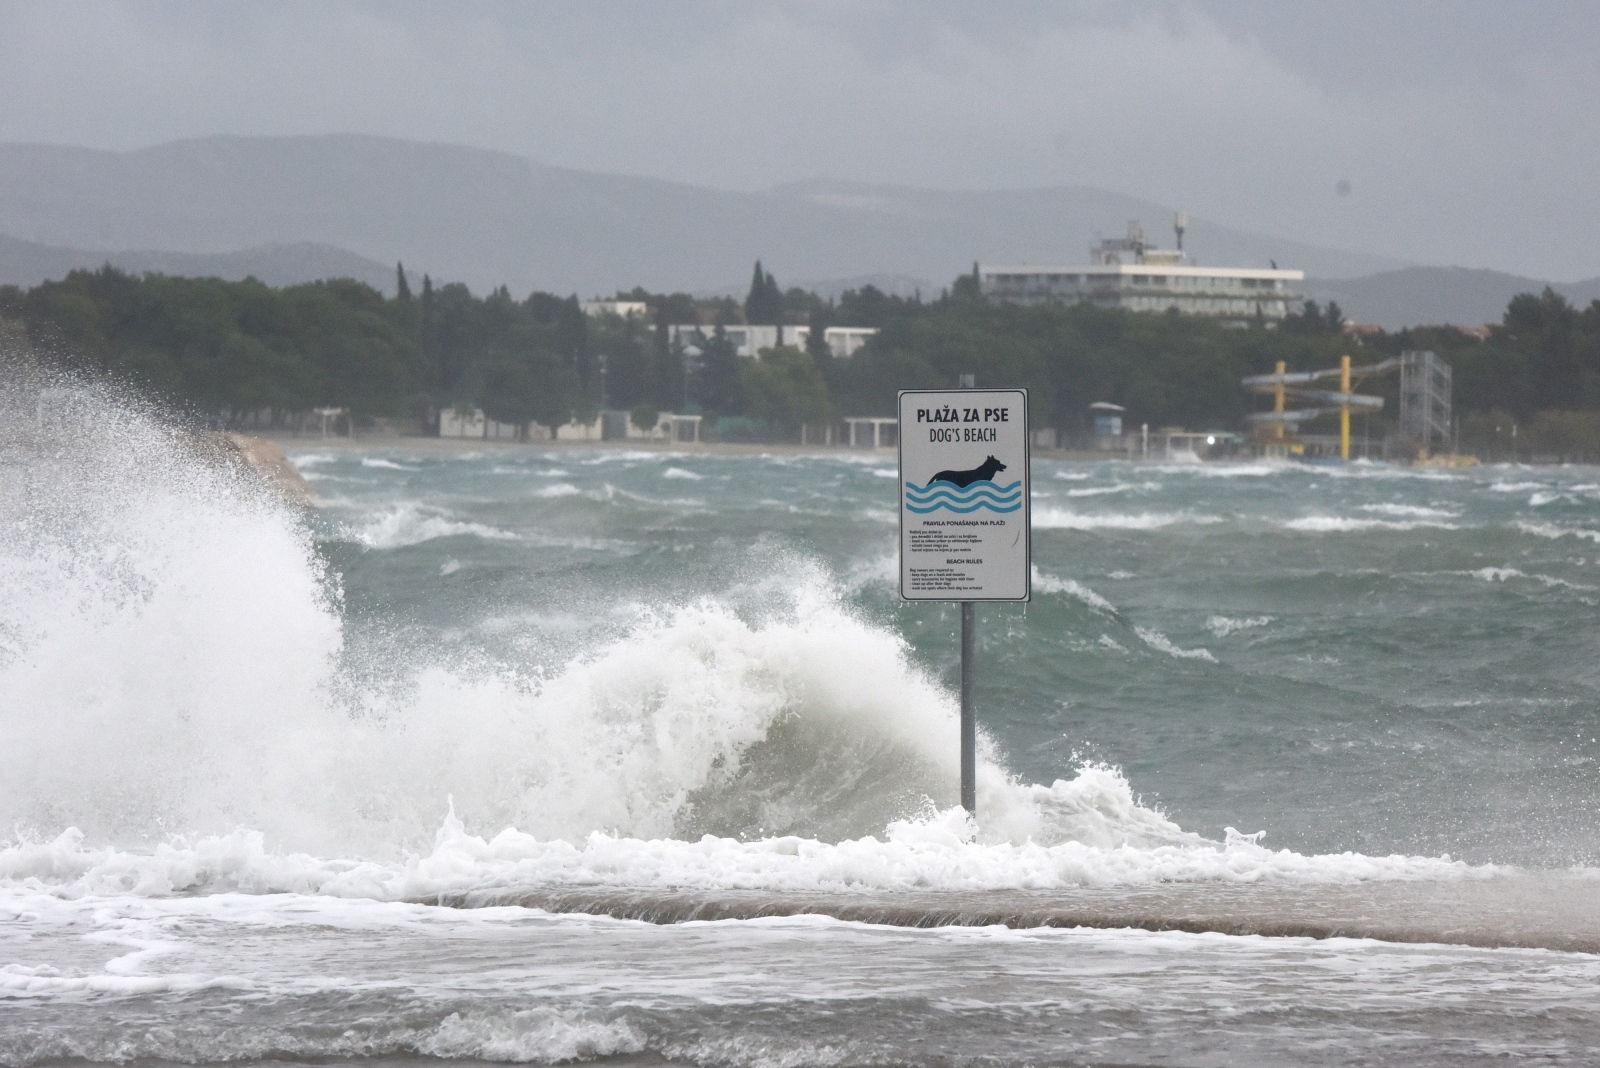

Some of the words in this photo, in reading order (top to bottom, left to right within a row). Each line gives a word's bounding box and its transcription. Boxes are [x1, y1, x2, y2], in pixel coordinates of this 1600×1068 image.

[917, 404, 960, 422] PLAŽA
[963, 408, 980, 422] ZA
[984, 408, 1008, 422] PSE
[930, 428, 960, 442] DOG'S
[964, 428, 996, 442] BEACH
